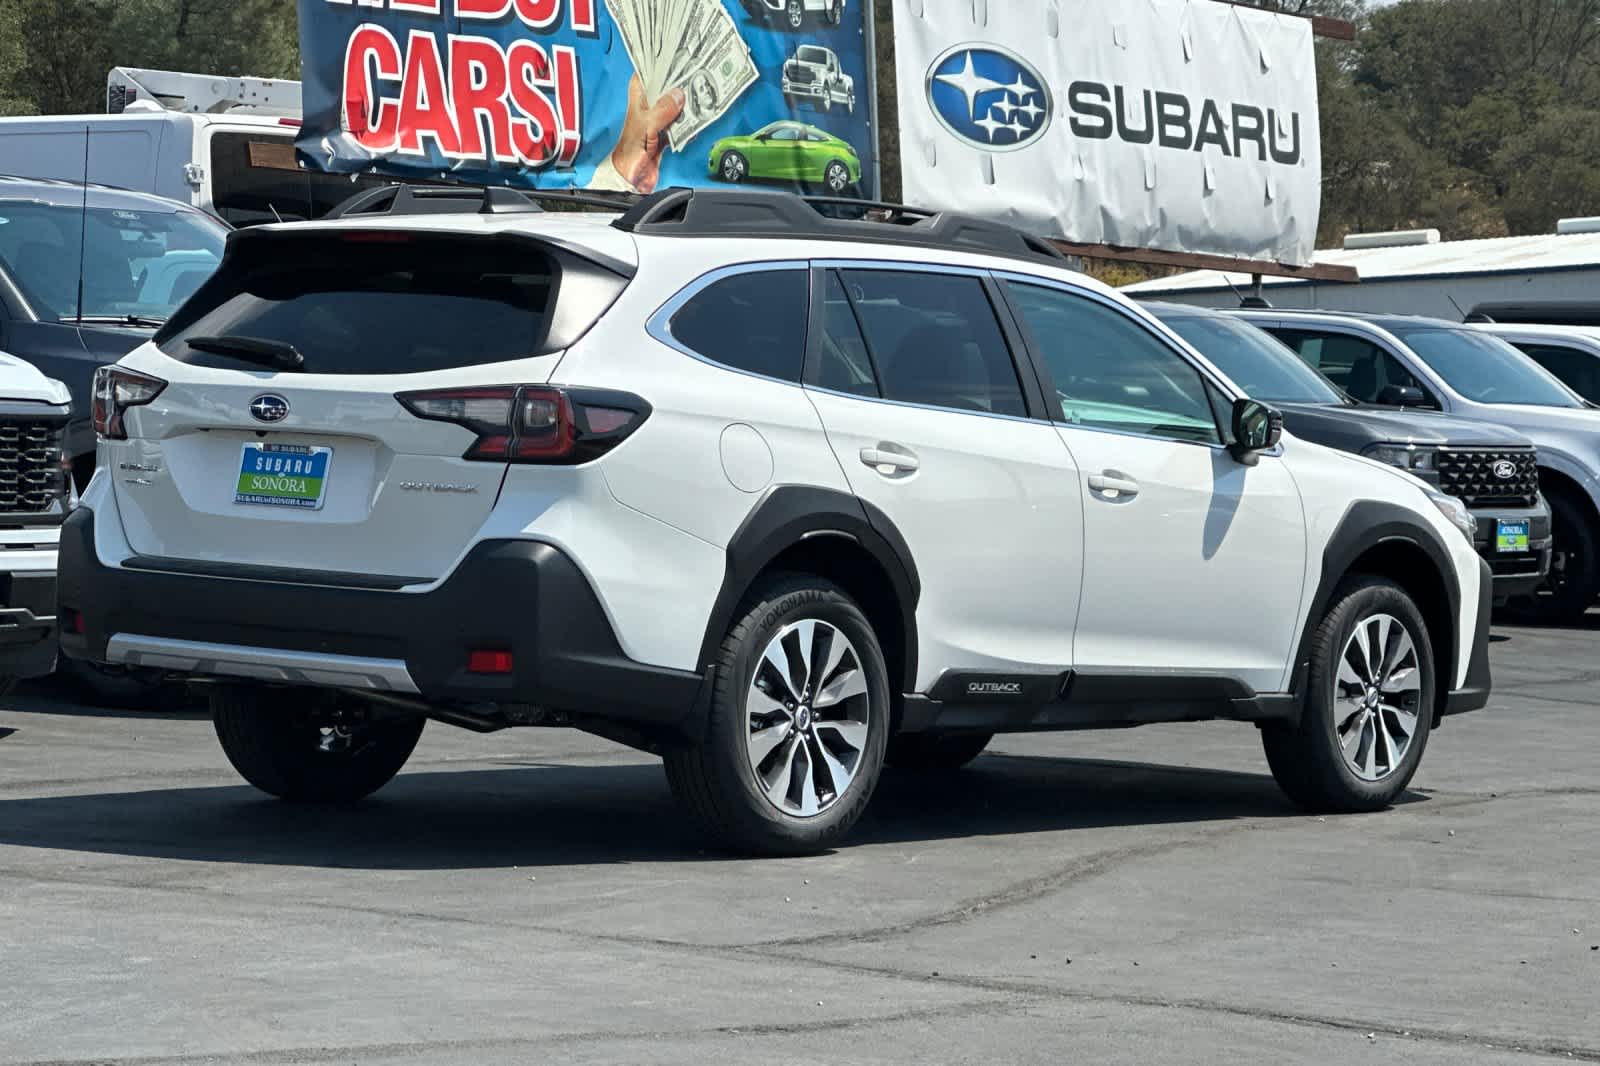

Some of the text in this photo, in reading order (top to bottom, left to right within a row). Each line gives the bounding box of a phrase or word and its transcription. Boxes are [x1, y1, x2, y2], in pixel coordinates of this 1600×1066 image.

[342, 23, 581, 167] CARS!
[1067, 80, 1301, 166] SUBARU
[255, 457, 313, 474] SUBARU
[251, 476, 307, 493] SONORA
[760, 590, 825, 630] YOKOHAMA
[968, 682, 1021, 692] OUTBACK
